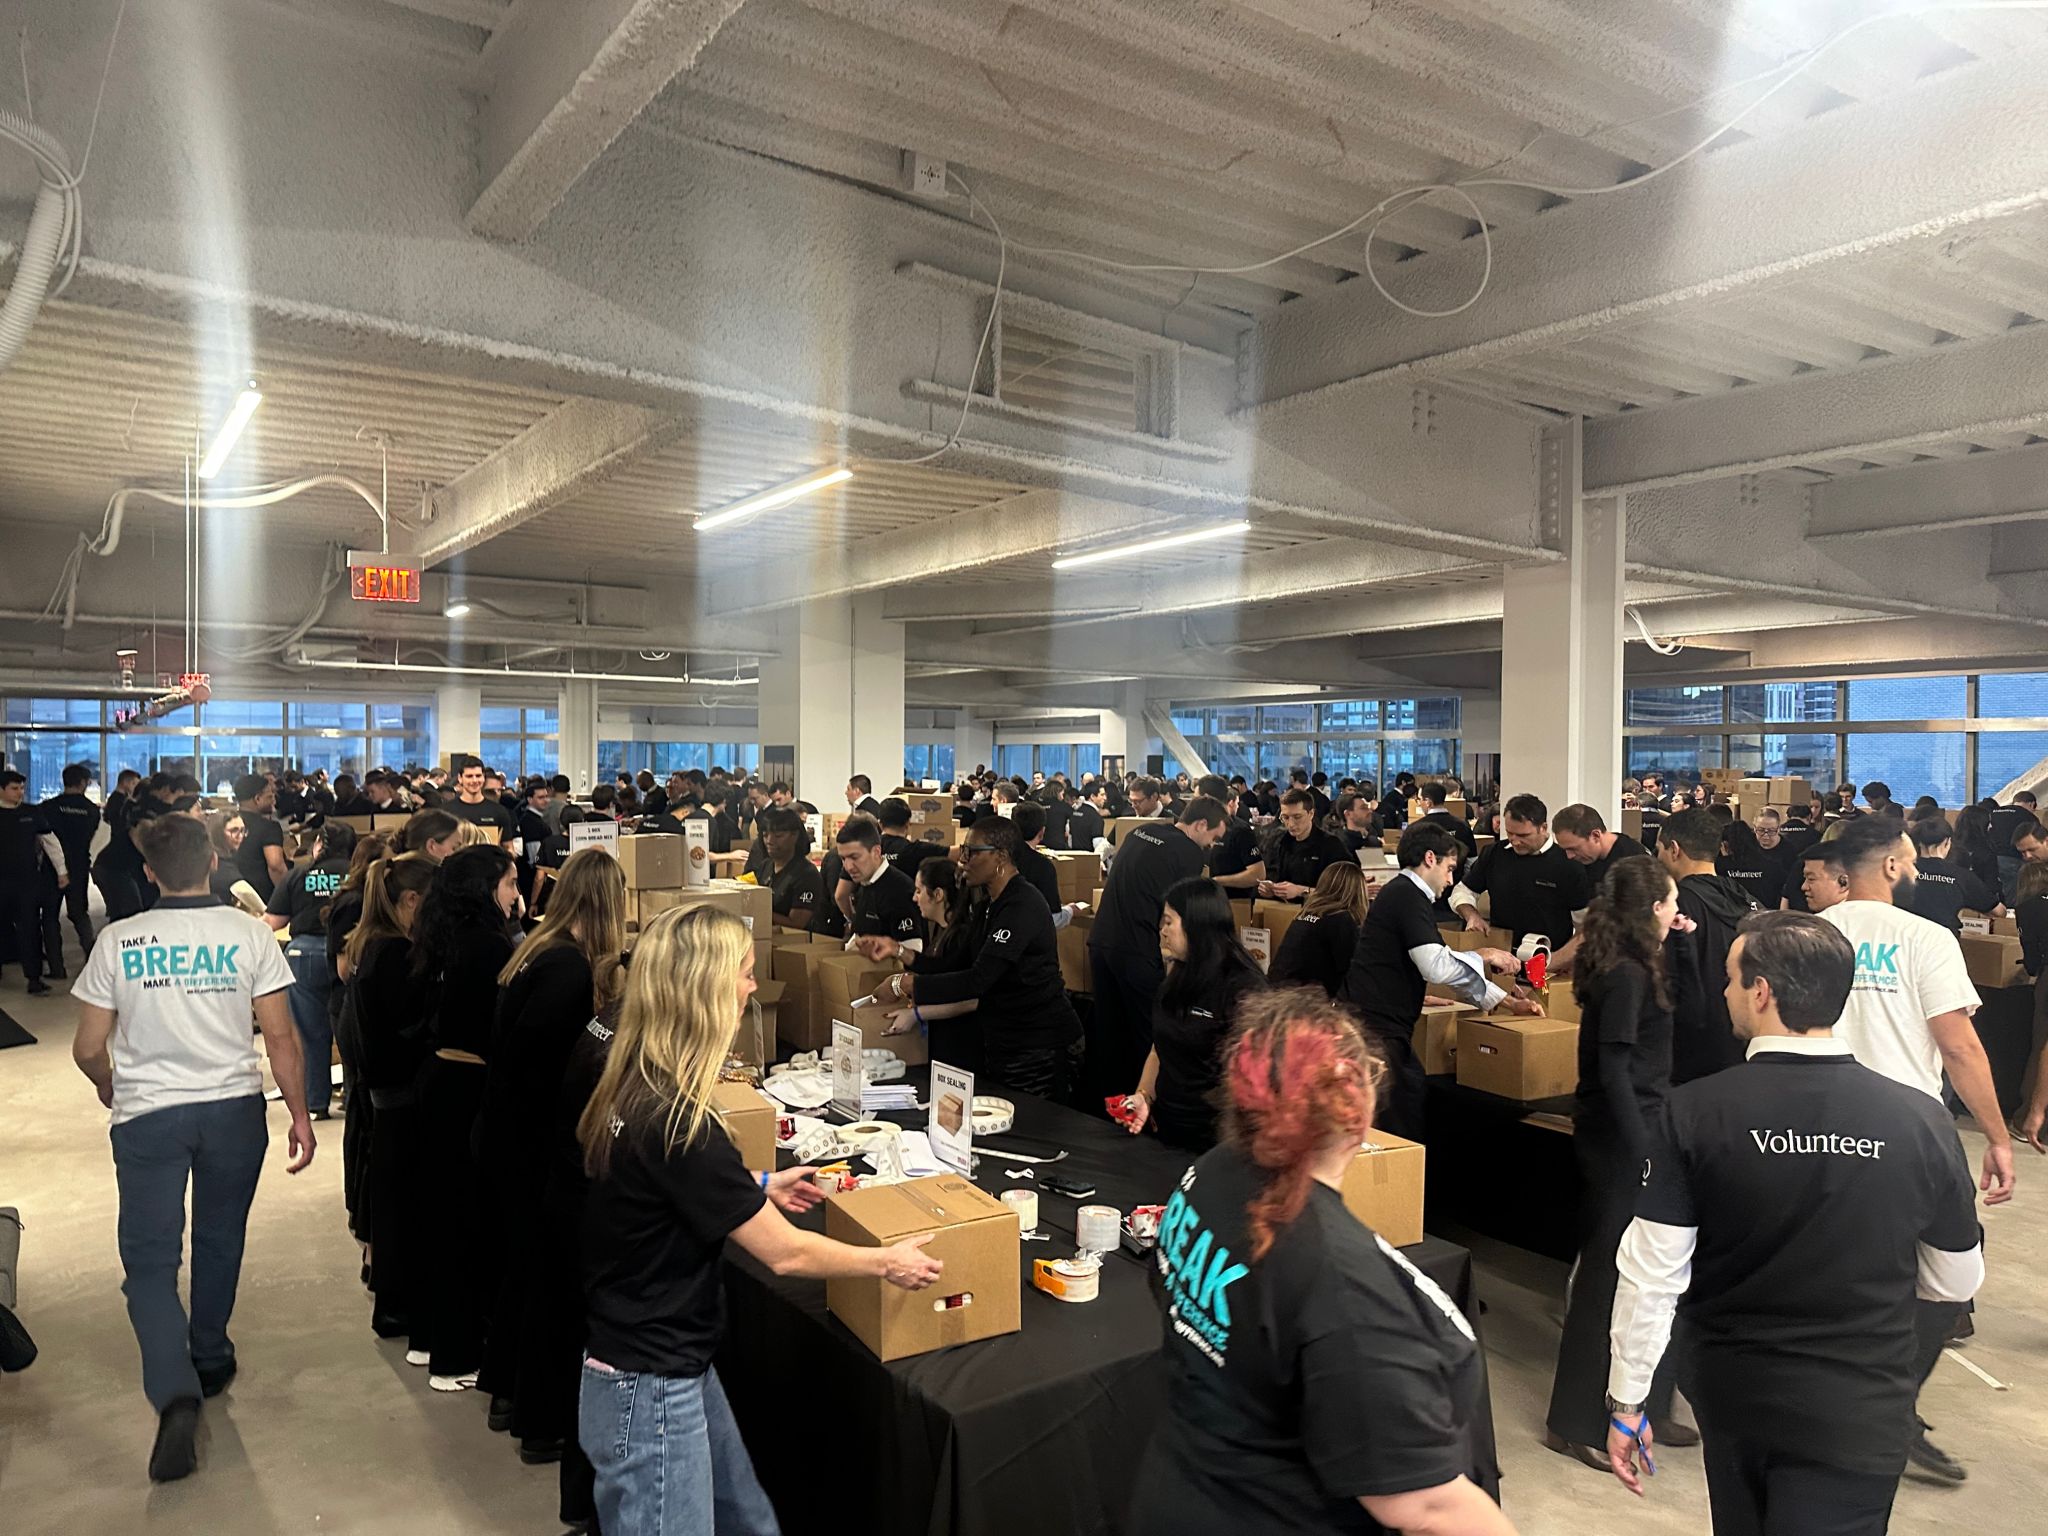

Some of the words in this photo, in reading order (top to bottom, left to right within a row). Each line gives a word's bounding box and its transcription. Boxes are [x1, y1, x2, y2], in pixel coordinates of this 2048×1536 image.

[365, 567, 410, 599] EXIT
[1727, 869, 1763, 879] Volunteer
[1916, 871, 1956, 885] olunteer
[799, 891, 814, 903] 40
[897, 918, 914, 932] 40
[120, 936, 147, 949] TAKE
[150, 935, 159, 944] A
[992, 928, 1012, 943] 40
[121, 944, 240, 981] BREAK
[143, 978, 171, 990] MAKE
[937, 1073, 946, 1084] BOX
[946, 1076, 967, 1091] SEALING
[1749, 1128, 1886, 1159] Volunteer
[1156, 1188, 1250, 1328] REAK
